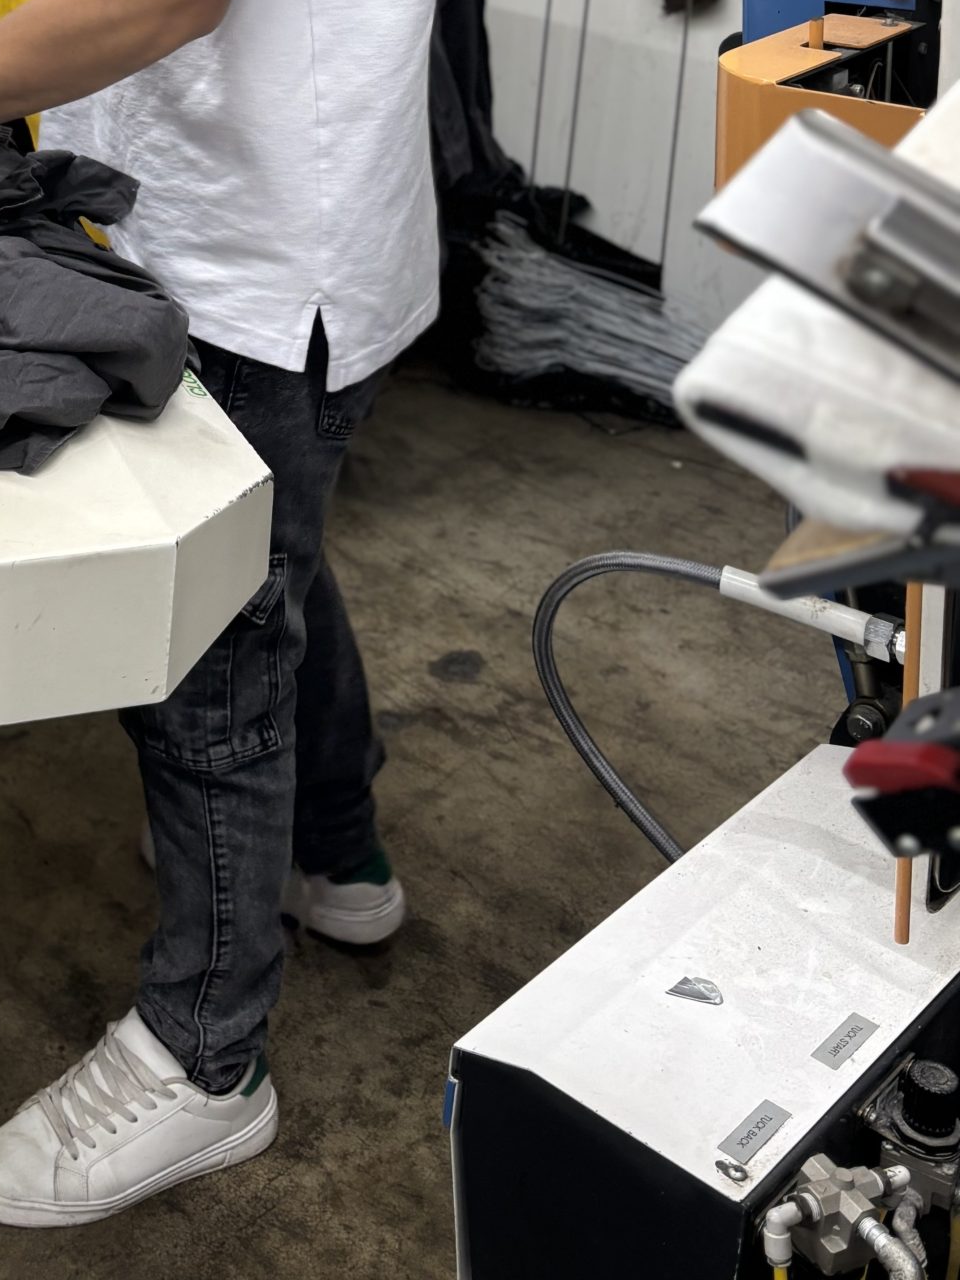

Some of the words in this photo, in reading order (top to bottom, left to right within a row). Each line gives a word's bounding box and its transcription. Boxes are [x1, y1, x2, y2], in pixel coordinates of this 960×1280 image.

[844, 1024, 864, 1040] TUCK
[828, 1038, 849, 1058] START
[752, 1114, 773, 1131] TUCK
[736, 1129, 757, 1148] BACK
